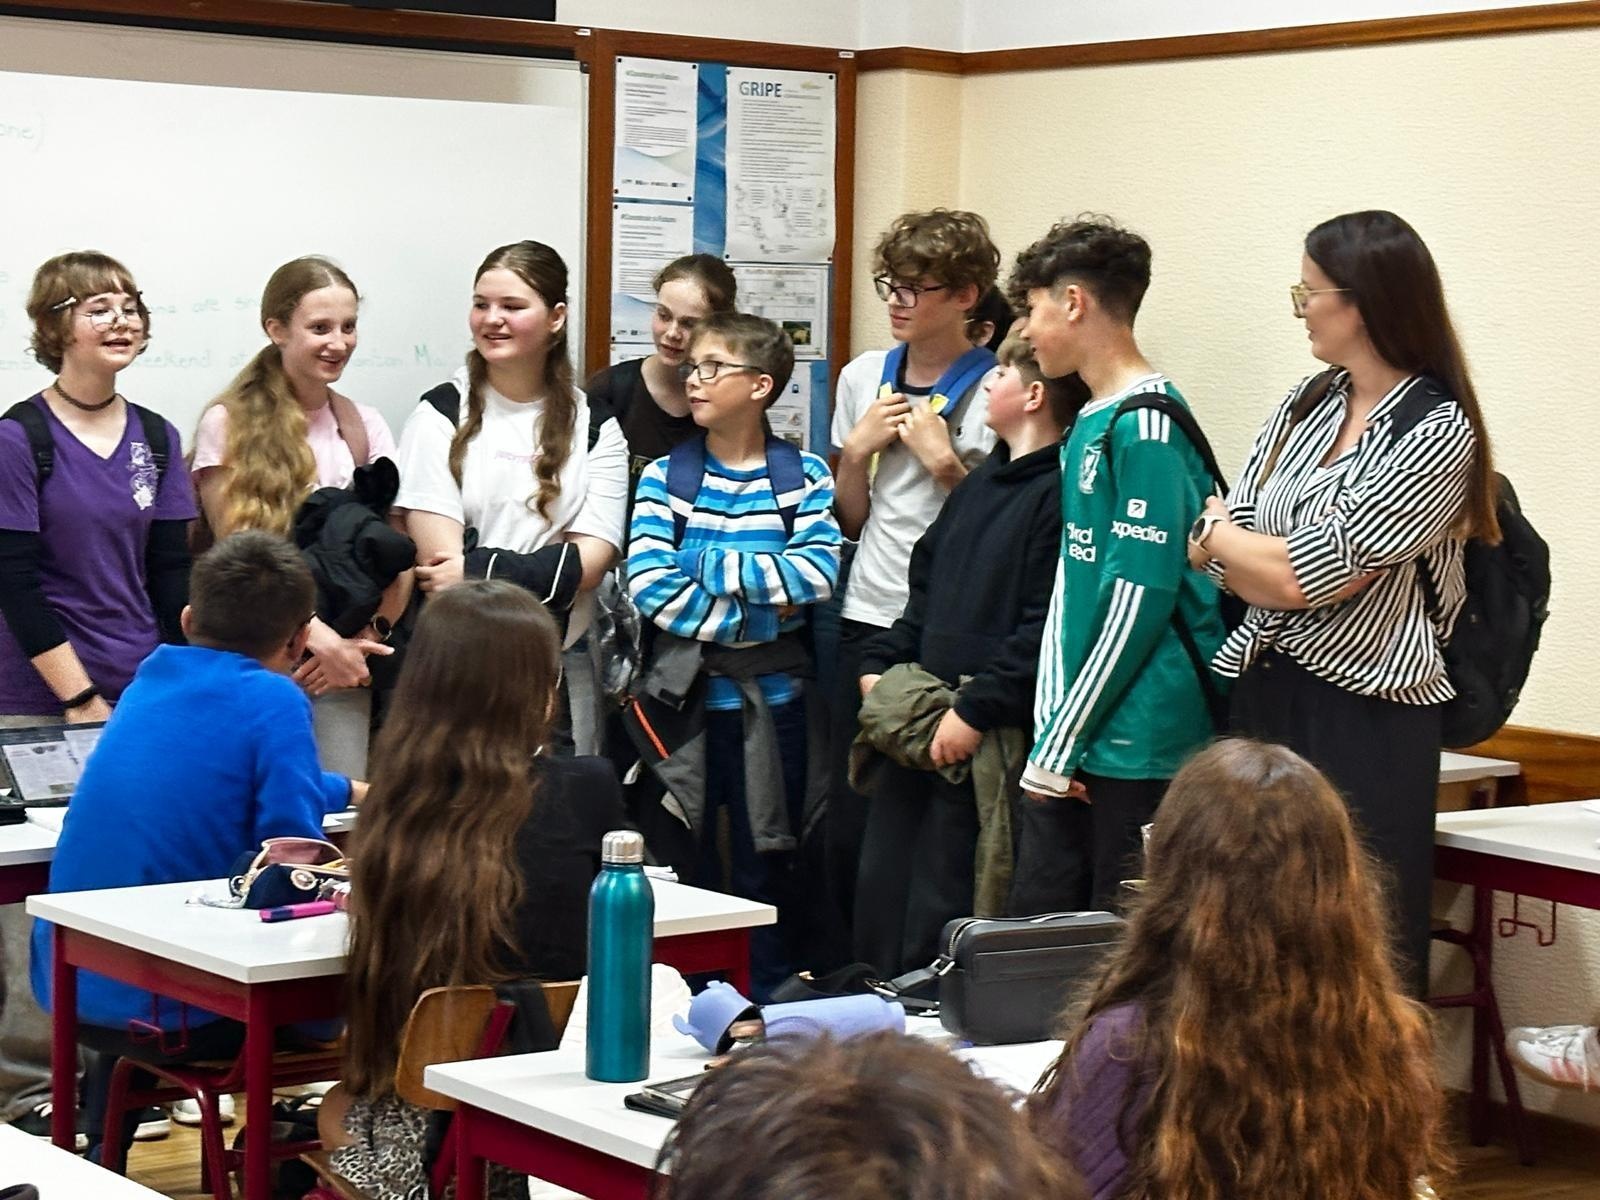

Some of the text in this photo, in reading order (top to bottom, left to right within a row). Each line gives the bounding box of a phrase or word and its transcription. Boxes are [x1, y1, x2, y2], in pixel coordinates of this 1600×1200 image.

[739, 81, 782, 98] GRIPE
[131, 348, 211, 368] eekend
[1110, 520, 1168, 544] xpedia
